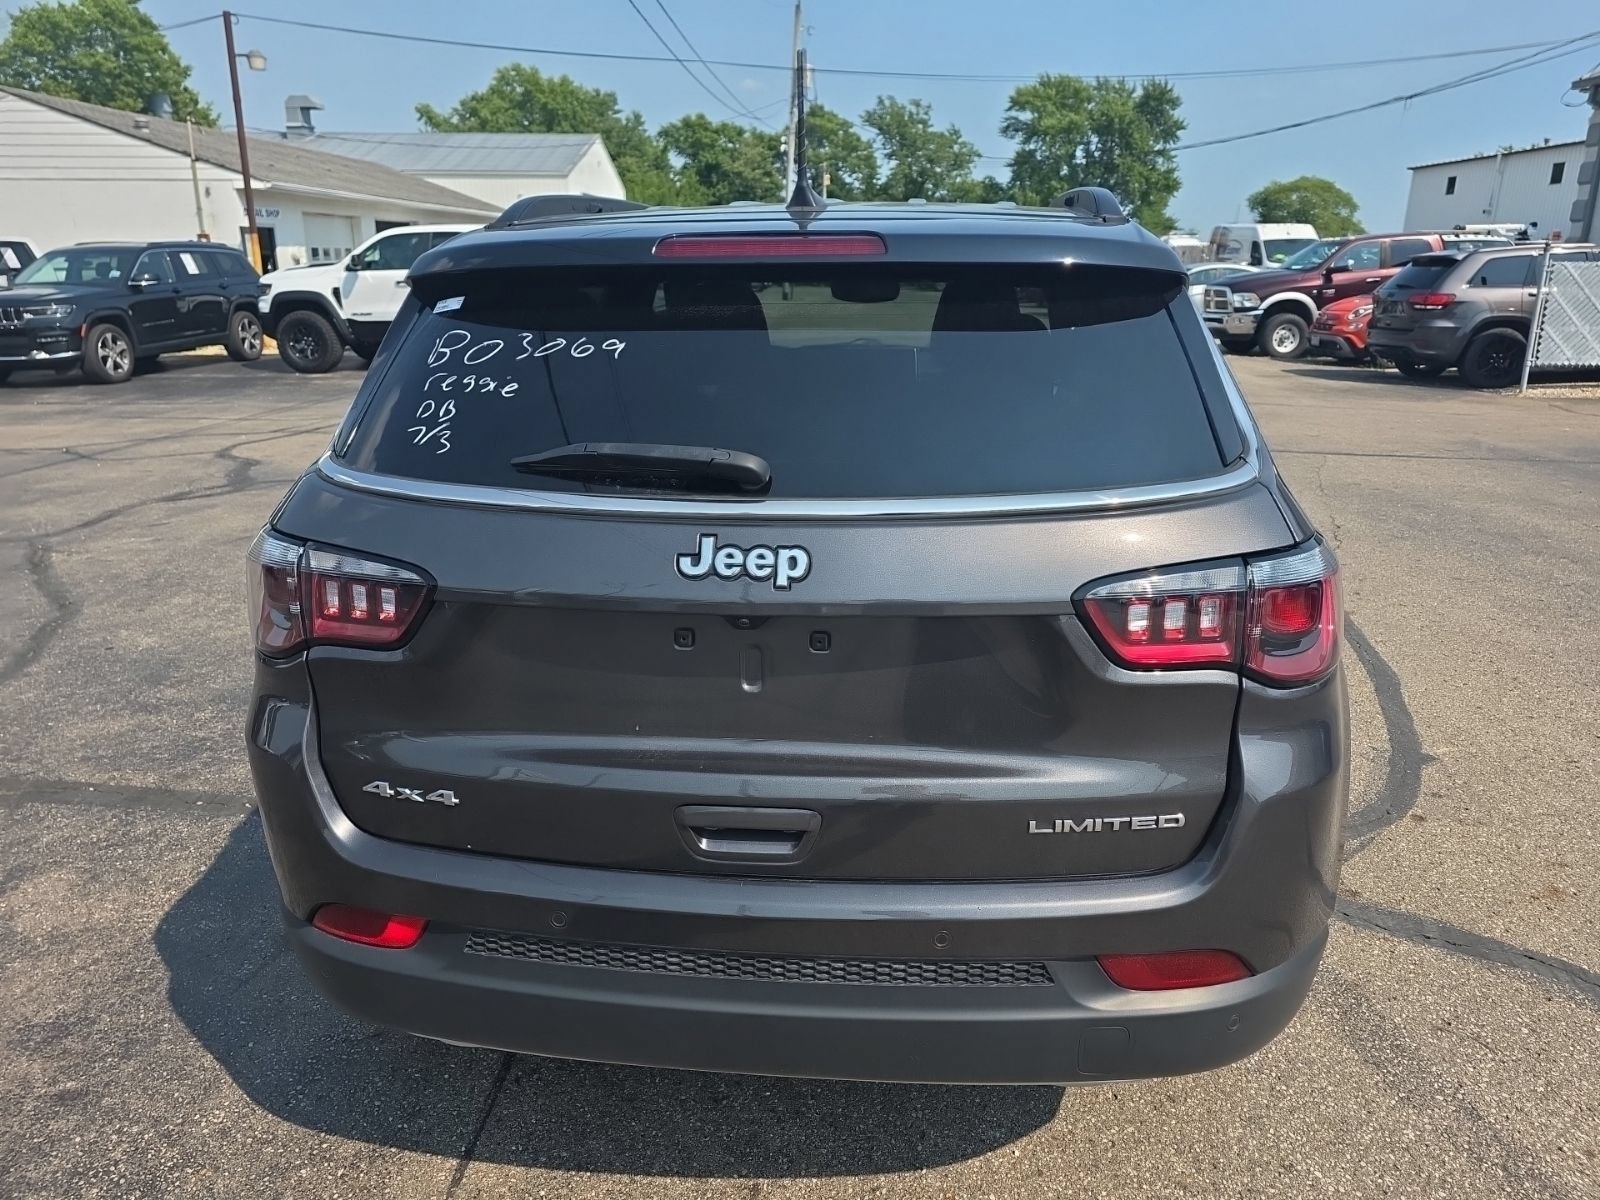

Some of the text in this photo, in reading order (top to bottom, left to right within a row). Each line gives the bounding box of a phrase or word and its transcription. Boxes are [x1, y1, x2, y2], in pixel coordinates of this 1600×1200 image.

[416, 399, 456, 422] DB
[407, 421, 452, 454] 7/3
[675, 533, 812, 591] Jeep
[1028, 812, 1186, 834] LIMITED
